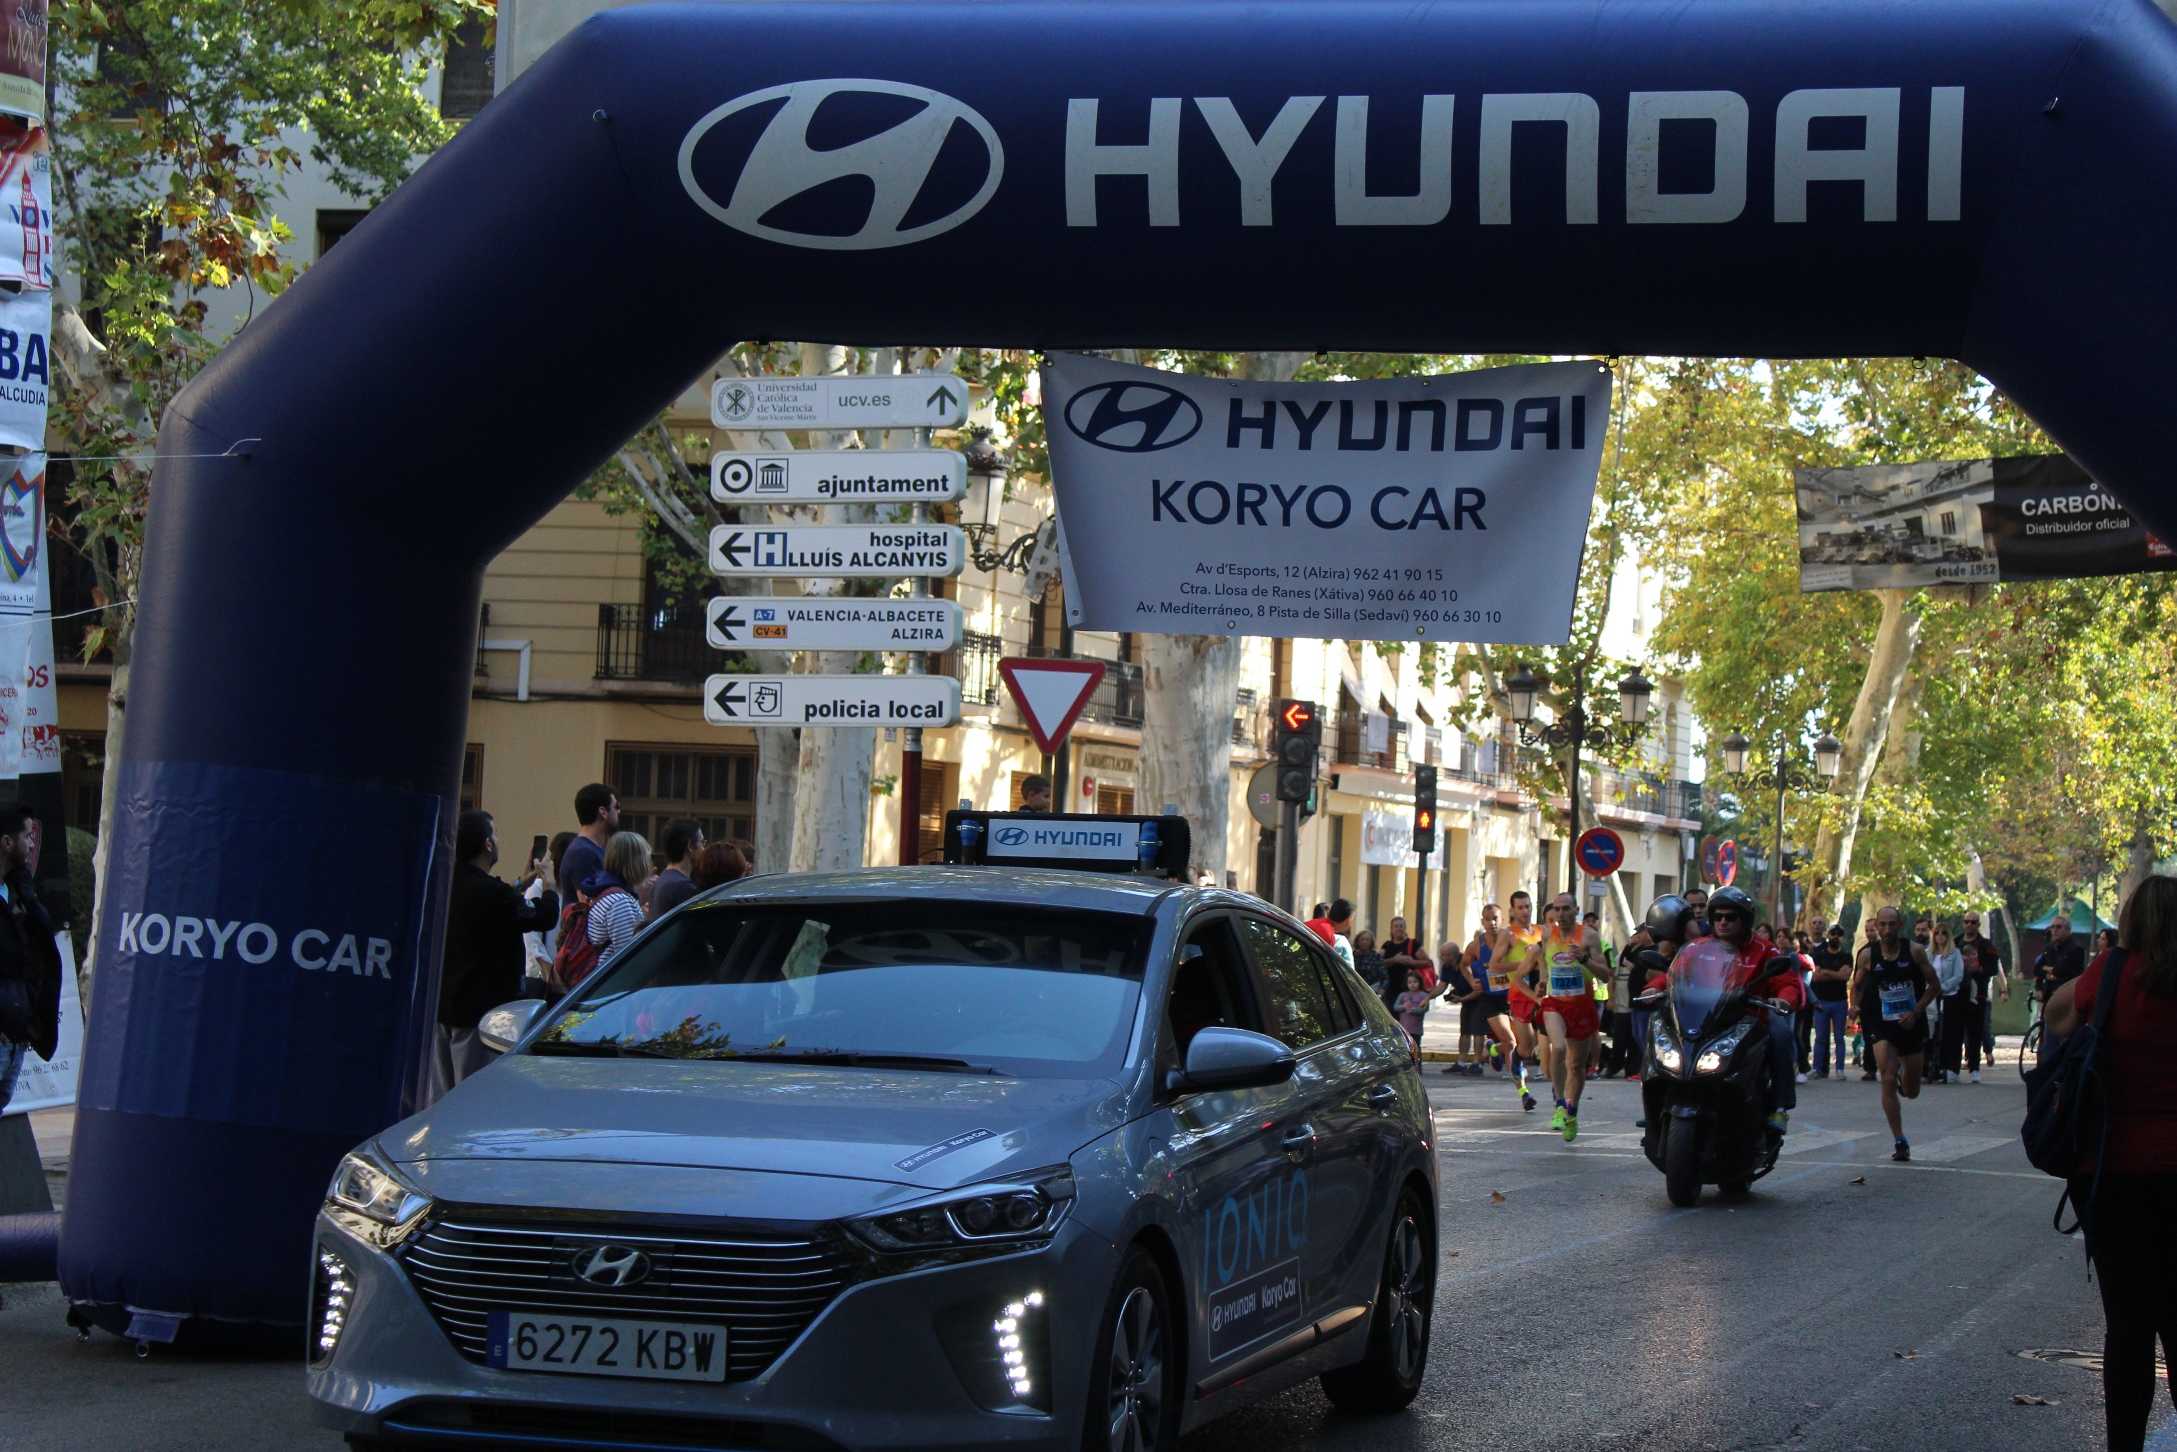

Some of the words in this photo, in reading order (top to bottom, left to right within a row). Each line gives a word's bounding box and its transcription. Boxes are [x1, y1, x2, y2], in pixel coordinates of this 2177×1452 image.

[1065, 86, 1965, 226] HYUNDAI
[0, 328, 48, 385] BA
[757, 382, 817, 393] Universidad
[757, 404, 769, 413] de
[772, 403, 814, 413] Valencia
[838, 393, 891, 408] ucv.es
[1226, 395, 1585, 452] HYUNDAI
[817, 474, 949, 498] ajuntament
[1151, 479, 1351, 530] KORYO
[1370, 486, 1487, 531] CAR
[2026, 520, 2093, 535] Distribuidor
[2095, 517, 2130, 531] oficial
[869, 531, 948, 551] hospital
[788, 547, 843, 567] LLUÍS
[849, 552, 947, 567] ALCANYIS
[1195, 562, 1213, 575] Av
[1216, 563, 1280, 579] d'Esports,
[1284, 566, 1299, 578] 12
[1303, 566, 1350, 582] (Alzira)
[1353, 568, 1379, 581] 962
[1383, 568, 1399, 581] 41
[1404, 568, 1421, 581] 90
[1426, 569, 1443, 581] 15
[1179, 582, 1211, 595] Ctra.
[1215, 583, 1248, 597] Llosa
[1251, 584, 1268, 597] de
[1272, 586, 1311, 599] Ranes
[1367, 589, 1394, 602] 960
[1398, 589, 1415, 602] 66
[1419, 589, 1437, 602] 40
[1441, 589, 1458, 602] 10
[1136, 602, 1157, 614] Av.
[1160, 602, 1253, 618] Mediterráneo,
[1257, 604, 1265, 617] 8
[1269, 606, 1299, 619] Pista
[1303, 607, 1320, 620] de
[1323, 607, 1350, 620] Silla
[1413, 609, 1439, 623] 960
[1442, 610, 1459, 623] 66
[1463, 610, 1481, 623] 30
[1486, 610, 1502, 624] 10
[755, 626, 787, 637] CV-41
[891, 628, 945, 640] ALZIRA
[889, 699, 944, 718] local
[1034, 829, 1122, 847] HYUNDAI
[118, 912, 278, 964] KORYO
[291, 928, 392, 979] CAR
[1224, 1292, 1257, 1325] HYUNDAI
[516, 1322, 619, 1367] 6272
[636, 1329, 715, 1373] KBW
